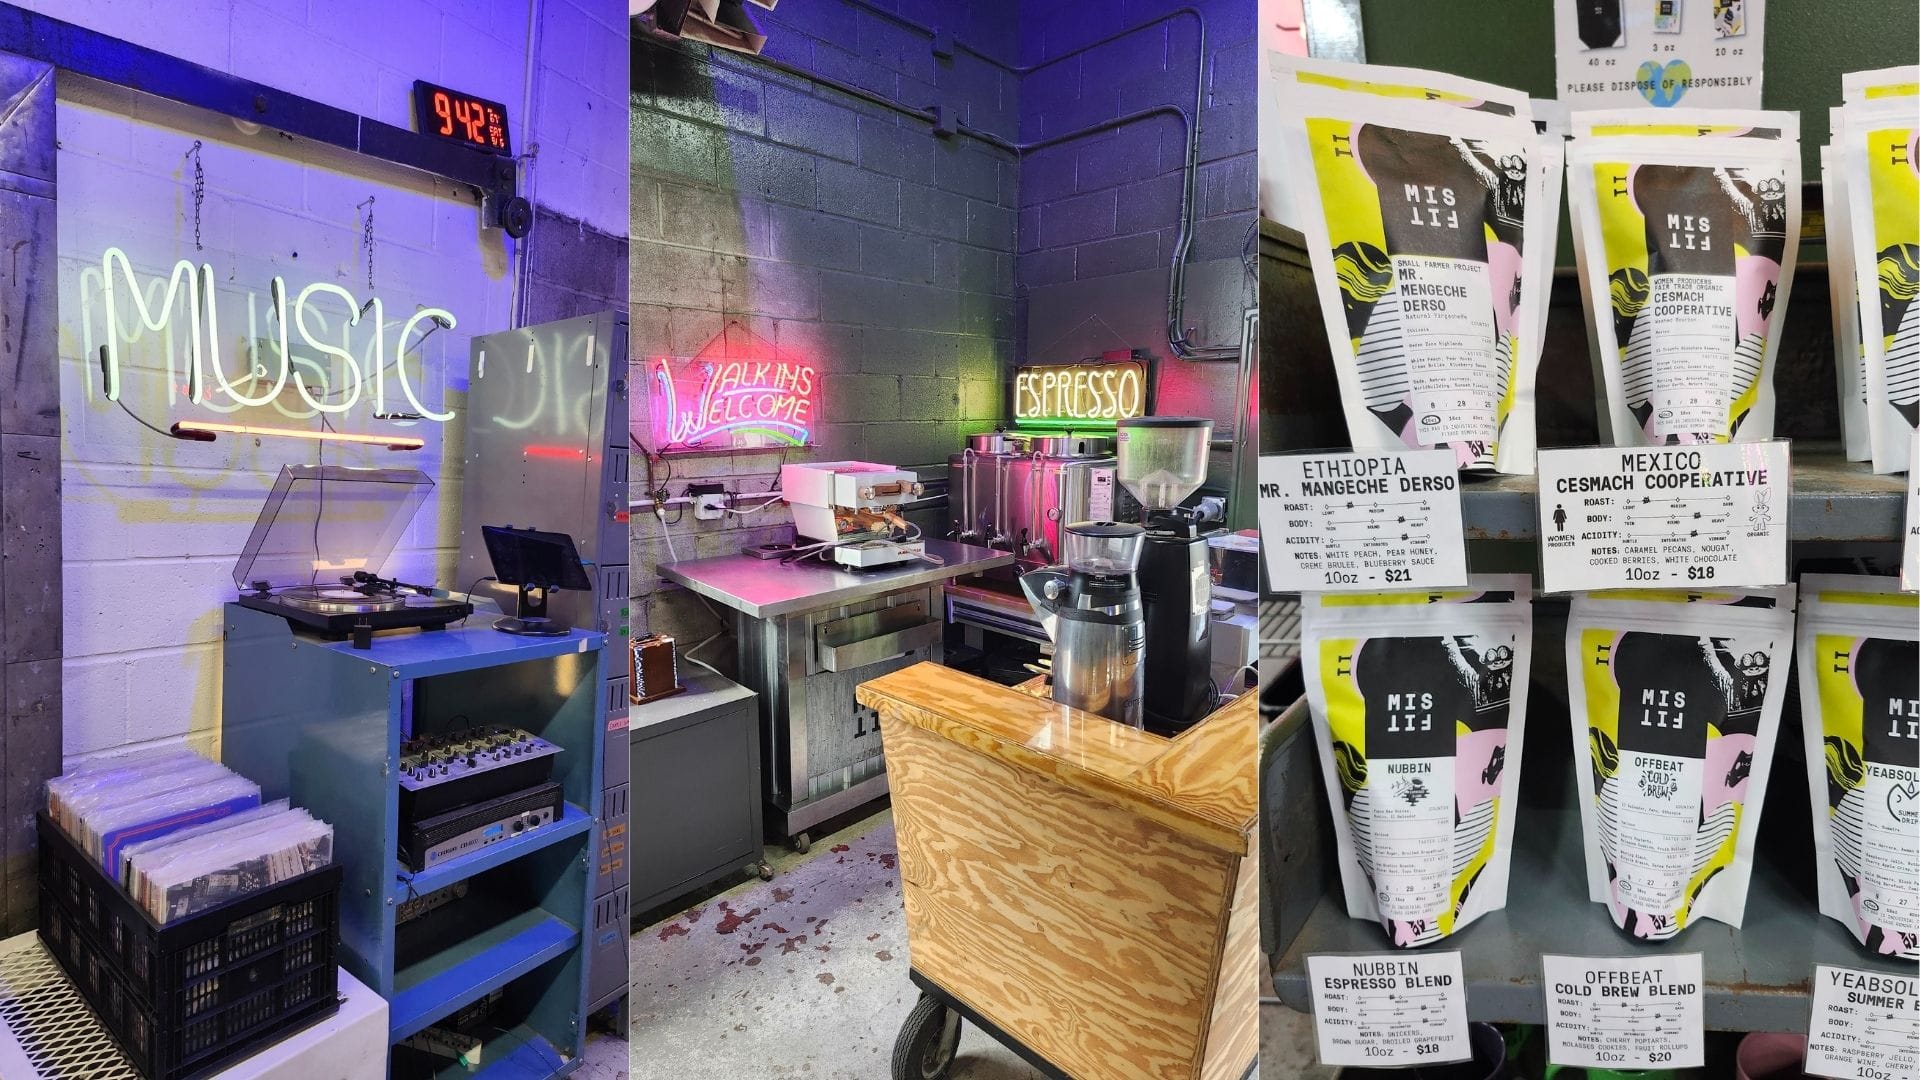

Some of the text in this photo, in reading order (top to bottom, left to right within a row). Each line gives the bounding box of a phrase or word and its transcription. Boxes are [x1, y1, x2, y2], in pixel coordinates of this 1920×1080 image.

[1652, 44, 1658, 52] 3
[1716, 48, 1726, 56] 10
[1588, 58, 1600, 66] 40
[1568, 77, 1752, 92] PLEASE DISPOSE OF RESPONSIBLY
[1404, 184, 1456, 206] MIS
[1667, 214, 1710, 232] MIS
[1425, 261, 1450, 269] FARMER
[1454, 264, 1481, 272] PROJECT
[1399, 269, 1423, 280] MR.
[1401, 284, 1467, 298] MENGECHE
[1655, 292, 1704, 303] CESMACH
[1404, 300, 1445, 312] DERSO
[1655, 305, 1732, 316] COOPERATIVE
[103, 247, 457, 421] MUSIC
[1016, 370, 1139, 418] ESPRESSO
[1622, 452, 1700, 472] MEXICO
[1303, 457, 1406, 479] ETHIOPIA
[1260, 476, 1454, 498] MR. MANGECHE DERSO
[1557, 470, 1768, 493] CESMACH COOPERATIVE
[1584, 498, 1614, 506] ROAST:
[1285, 504, 1313, 512] ROAST:
[1289, 520, 1313, 528] BODY:
[1286, 537, 1324, 545] ACIDITY:
[1547, 534, 1575, 542] WOMEN
[1582, 531, 1622, 540] ACIDITY:
[1294, 552, 1321, 560] NOTES:
[1326, 551, 1350, 559] WHITE
[1591, 547, 1620, 555] NOTES:
[1624, 546, 1658, 554] CARAMEL
[1663, 545, 1696, 554] PECANS,
[1300, 561, 1323, 569] CREME
[1364, 559, 1406, 568] BLUEBERRY
[1590, 554, 1737, 565] COOKED BERRIES, WHITE CHOCOLATE
[1325, 569, 1412, 584] 10oz $21
[1626, 566, 1715, 580] 10oz $18
[1388, 693, 1433, 711] MIS
[1642, 689, 1686, 708] MIS
[1388, 763, 1431, 774] NUBBIN
[1635, 757, 1684, 772] OFFBEAT
[1647, 770, 1669, 784] COLD
[1647, 784, 1669, 798] BREW
[1353, 962, 1418, 977] NUBBIN
[1325, 975, 1452, 989] ESPRESSO BLEND
[1585, 970, 1662, 984] OFFBEAT
[1556, 983, 1696, 997] COLD BREW BLEND
[1848, 992, 1904, 1009] SUMMER
[1560, 1010, 1581, 1018] BODY:
[1828, 1005, 1858, 1015] ROAST:
[1324, 1018, 1357, 1026] ACIDITY:
[1556, 1022, 1590, 1031] ACIDITY:
[1829, 1019, 1853, 1028] BODY:
[1821, 1032, 1860, 1042] ACIDITY:
[1365, 1044, 1440, 1056] 10oz $18
[1562, 1041, 1594, 1050] MOLASSES
[1596, 1052, 1672, 1062] 10oz $20
[1810, 1044, 1838, 1052] NOTES:
[1842, 1048, 1884, 1059] RASPBERRY
[1825, 1054, 1852, 1063] ORANGE
[1857, 1067, 1891, 1080] 10oz
